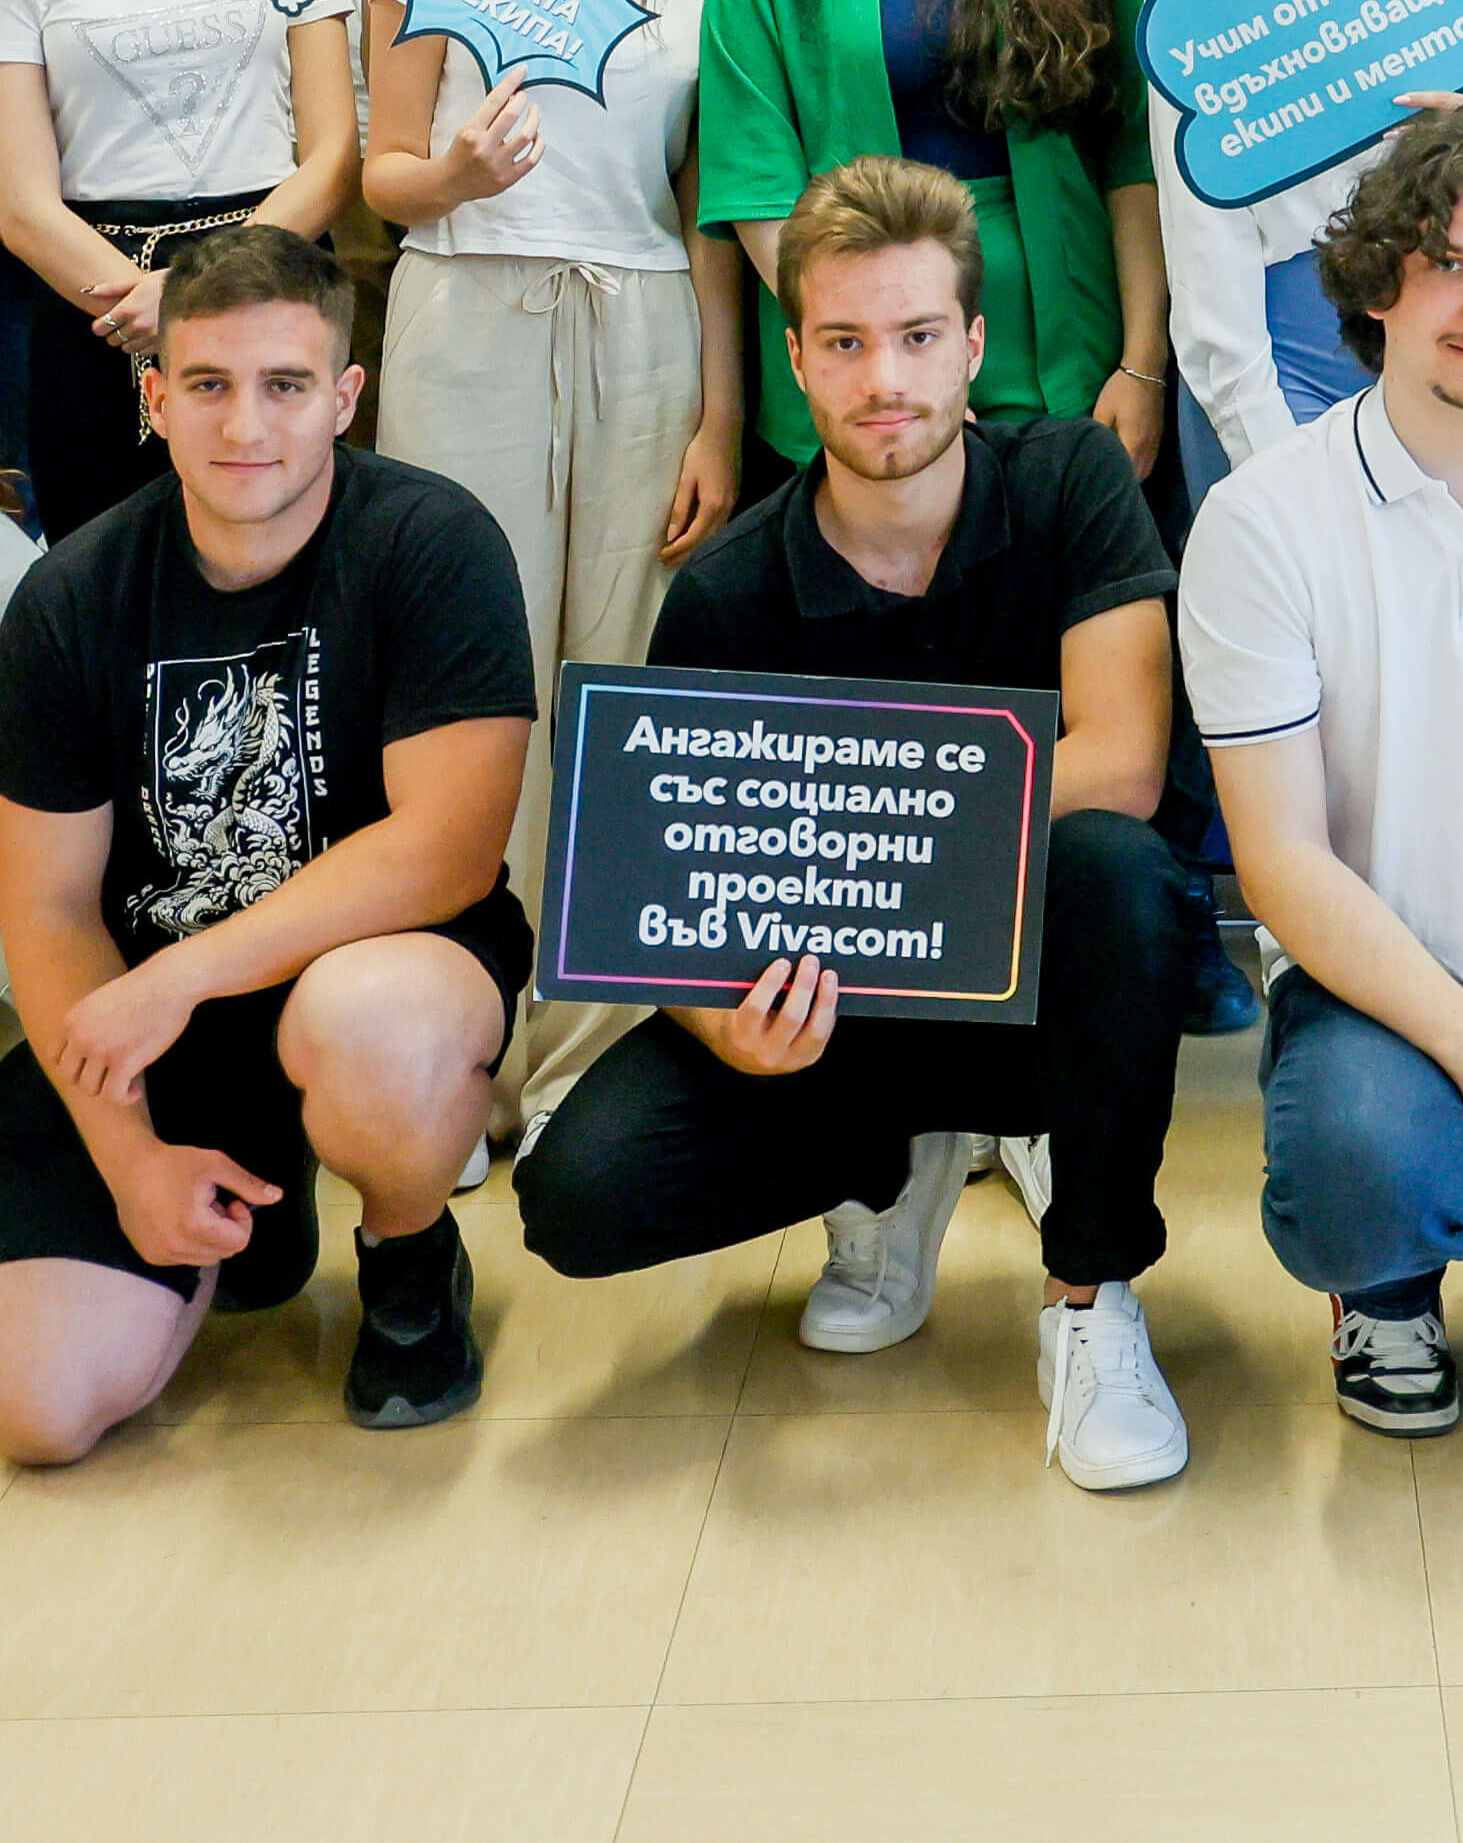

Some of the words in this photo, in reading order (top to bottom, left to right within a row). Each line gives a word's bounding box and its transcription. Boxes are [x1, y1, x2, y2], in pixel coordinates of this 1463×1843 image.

[111, 10, 248, 64] GUESS
[1168, 13, 1270, 77] Учим
[1219, 91, 1325, 158] екипи
[1328, 78, 1353, 104] и
[304, 626, 328, 798] LEGENDS
[623, 714, 925, 775] Ангажираме
[935, 741, 986, 774] се
[649, 772, 728, 807] със
[736, 777, 956, 819] социално
[663, 817, 934, 871] отговорни
[687, 865, 903, 911] проекти
[638, 904, 728, 951] във
[737, 911, 944, 960] Vivacom!
